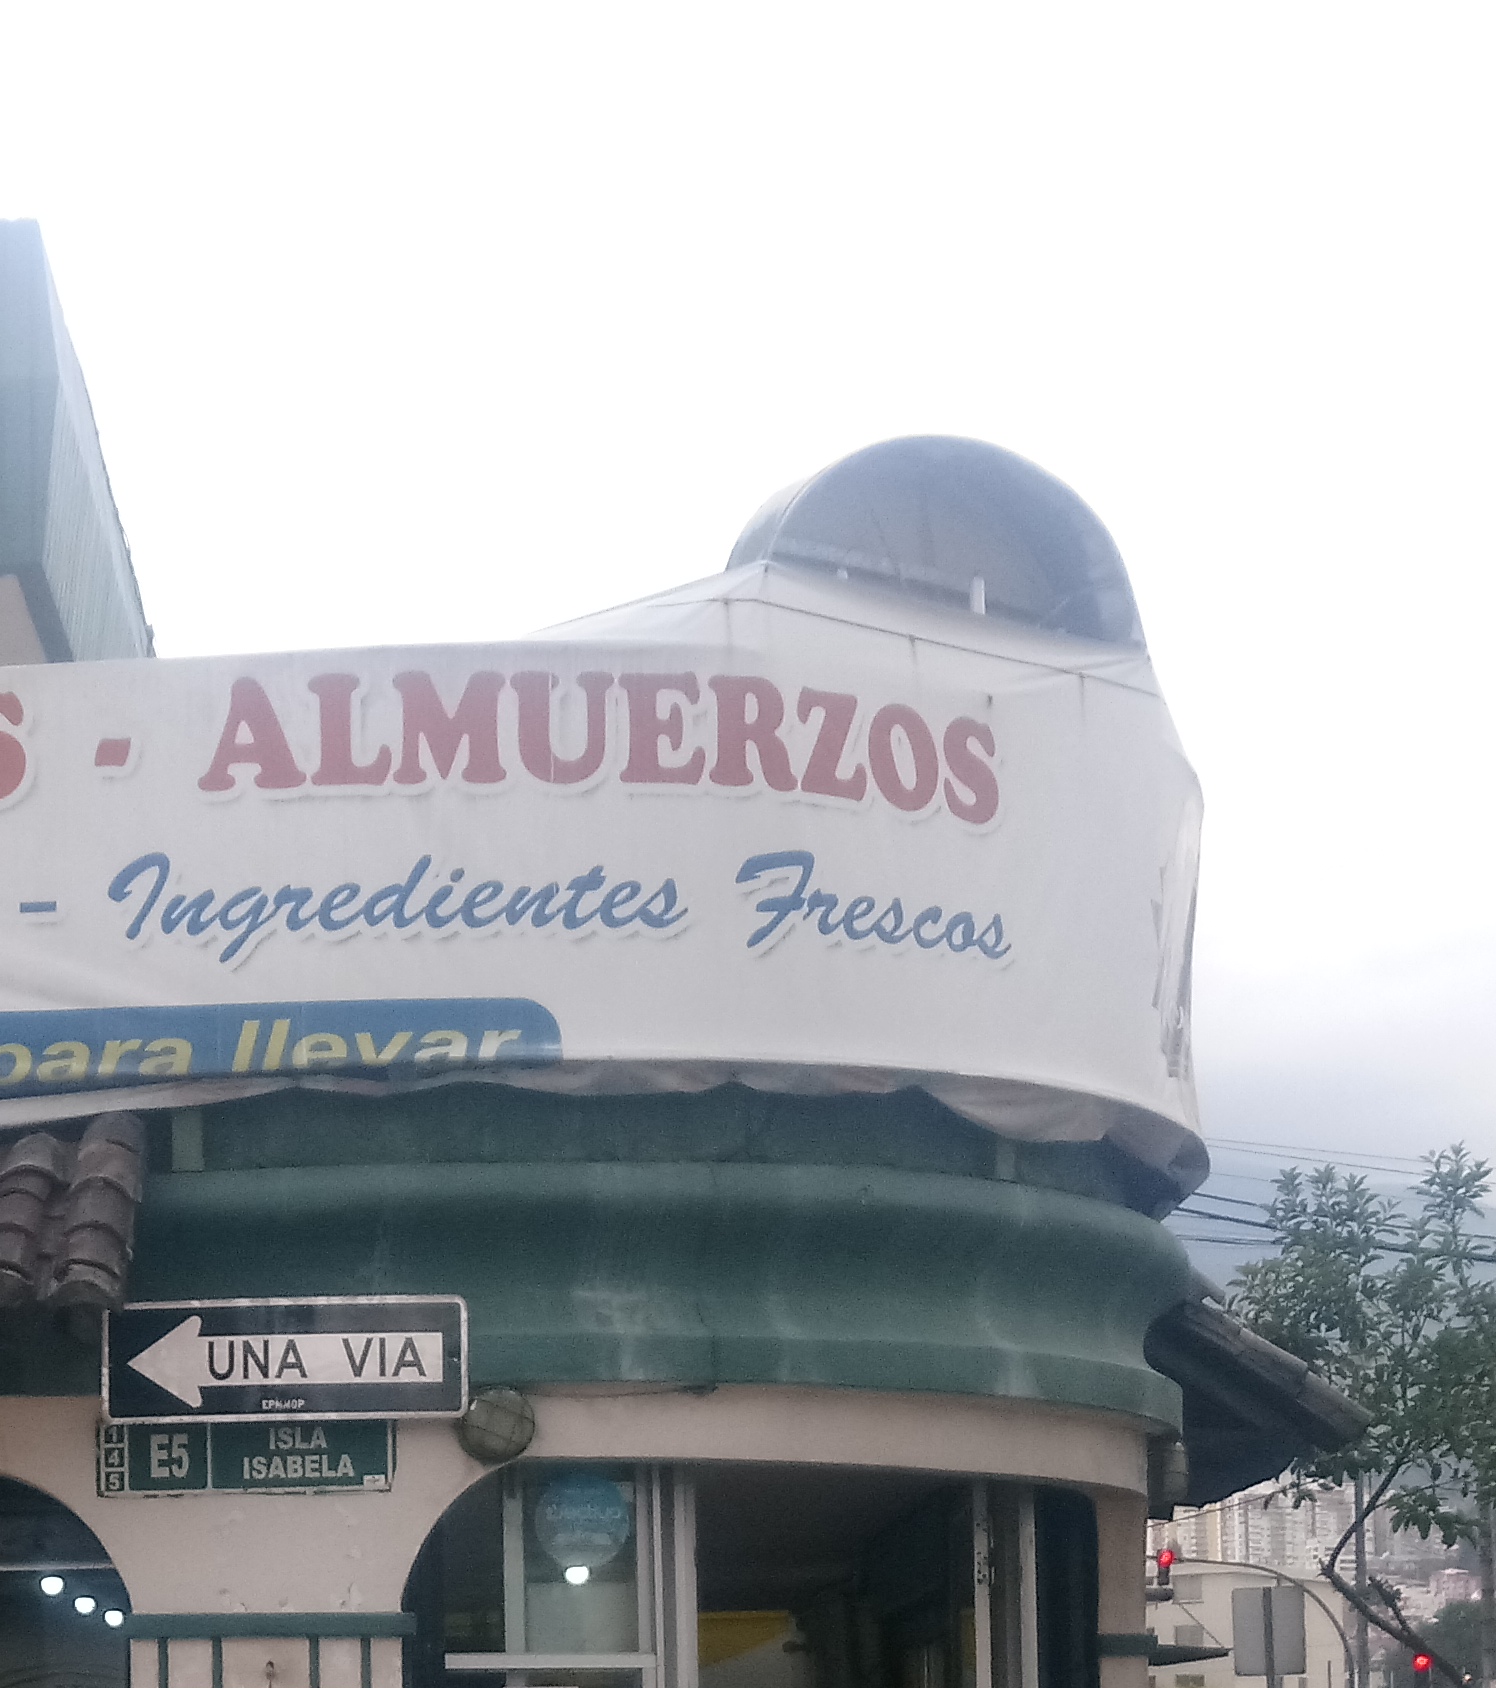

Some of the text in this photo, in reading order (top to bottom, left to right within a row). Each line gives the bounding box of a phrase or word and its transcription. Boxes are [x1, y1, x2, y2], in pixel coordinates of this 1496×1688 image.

[198, 669, 1001, 825] ALMUERZOS
[108, 851, 688, 963] Ingredientes
[735, 849, 1012, 961] Frescos
[231, 1018, 523, 1074] llevar
[207, 1336, 428, 1381] UNA VIA
[261, 1398, 306, 1410] EPMMOP
[149, 1434, 190, 1479] E5
[269, 1426, 328, 1451] ISLA
[242, 1454, 355, 1480] ISABELA
